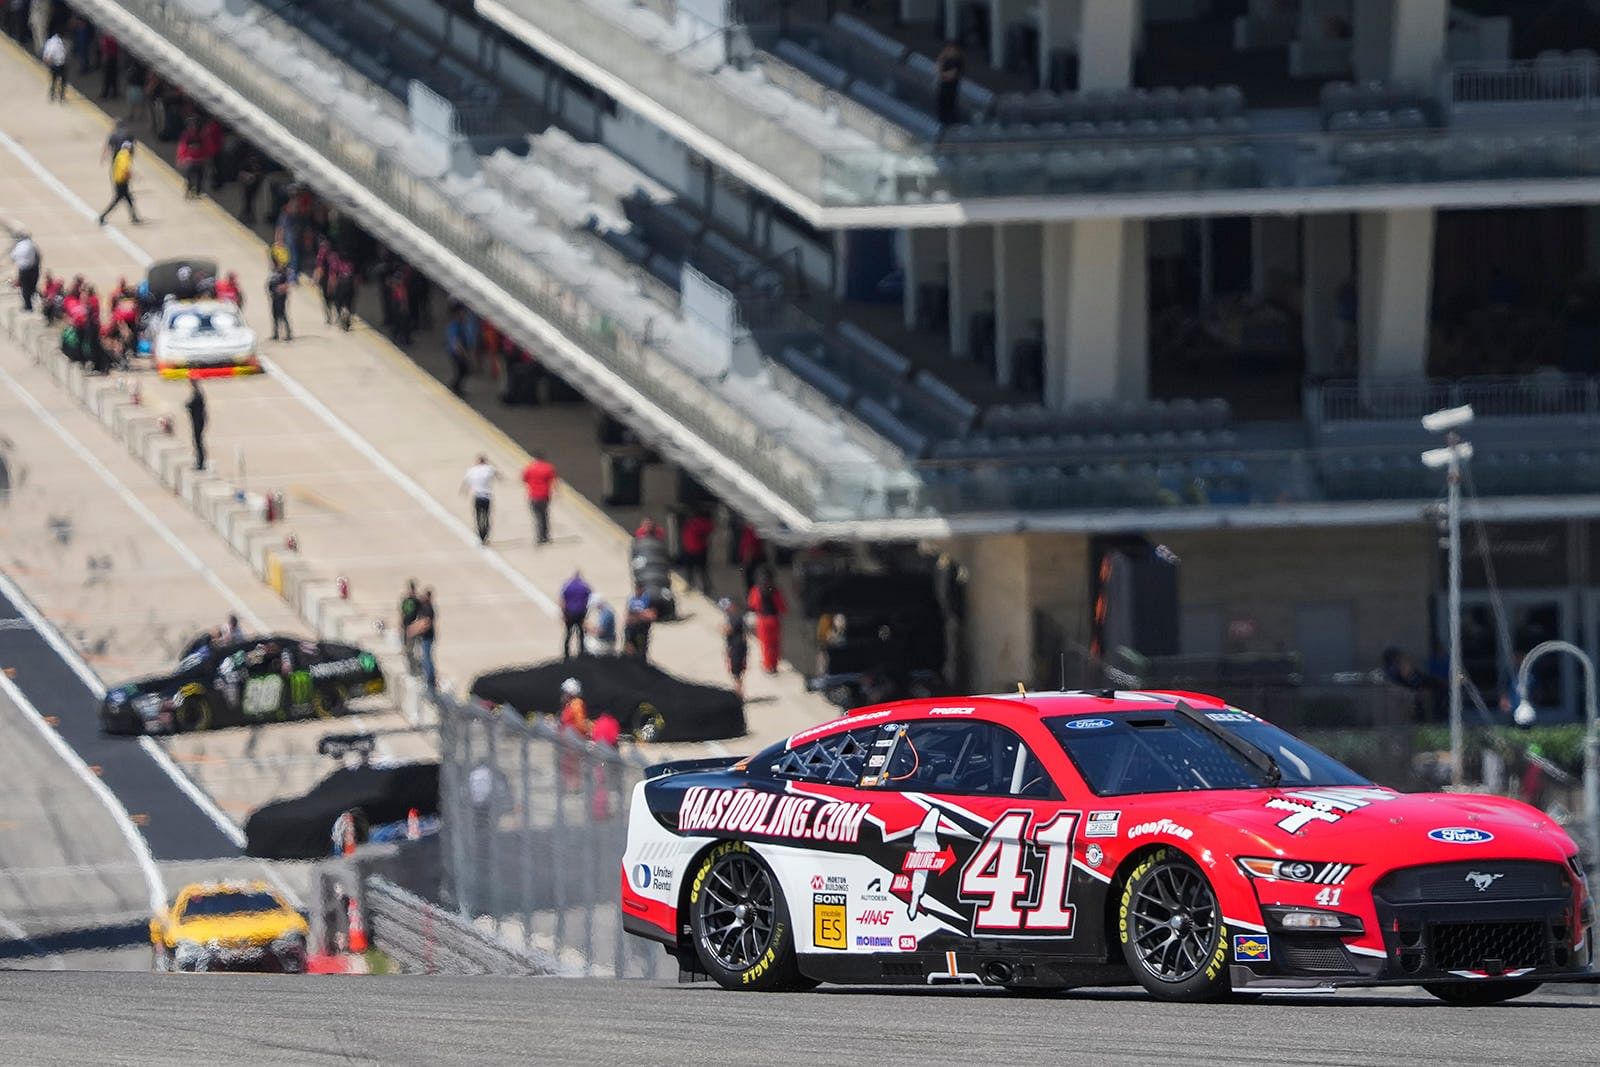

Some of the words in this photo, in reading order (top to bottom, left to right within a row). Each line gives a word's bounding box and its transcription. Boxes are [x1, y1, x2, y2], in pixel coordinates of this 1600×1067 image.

[678, 786, 871, 842] HAASTOOLING.COM
[1128, 818, 1193, 840] GOODYEAR
[691, 841, 751, 904] GOODYEAR
[958, 809, 1083, 939] 41
[814, 895, 846, 904] SONY
[1119, 848, 1166, 944] GOODYEAR
[1314, 887, 1344, 906] 41
[821, 918, 842, 941] ES
[856, 935, 893, 947] MOHAWK
[743, 947, 777, 984] EAGLE
[1206, 924, 1227, 981] EAGLE
